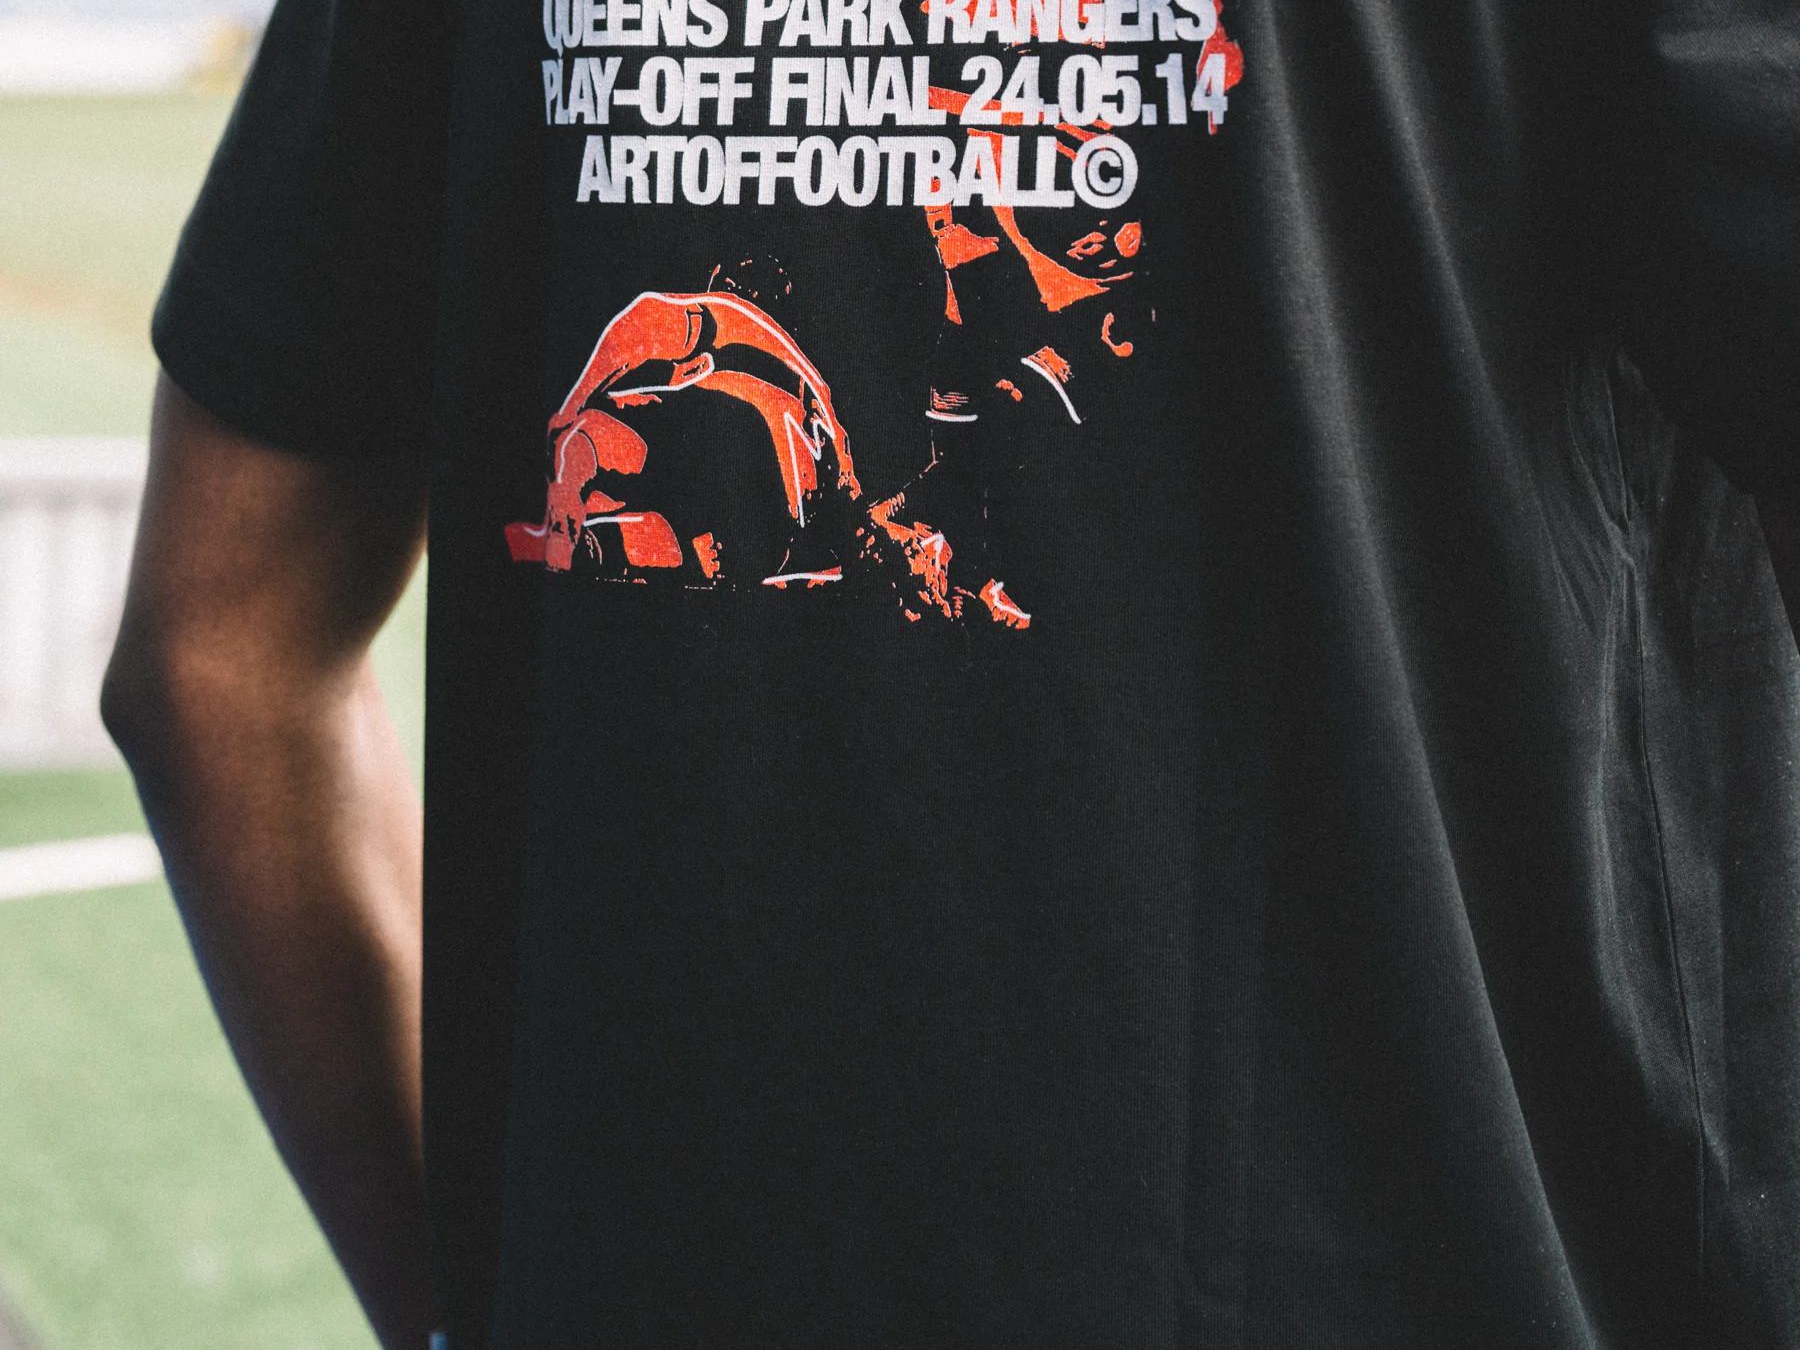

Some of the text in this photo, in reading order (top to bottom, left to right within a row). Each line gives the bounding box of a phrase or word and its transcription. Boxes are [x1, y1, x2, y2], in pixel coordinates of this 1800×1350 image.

[542, 53, 1229, 126] PLAY-OFF FINAL 24.05.14
